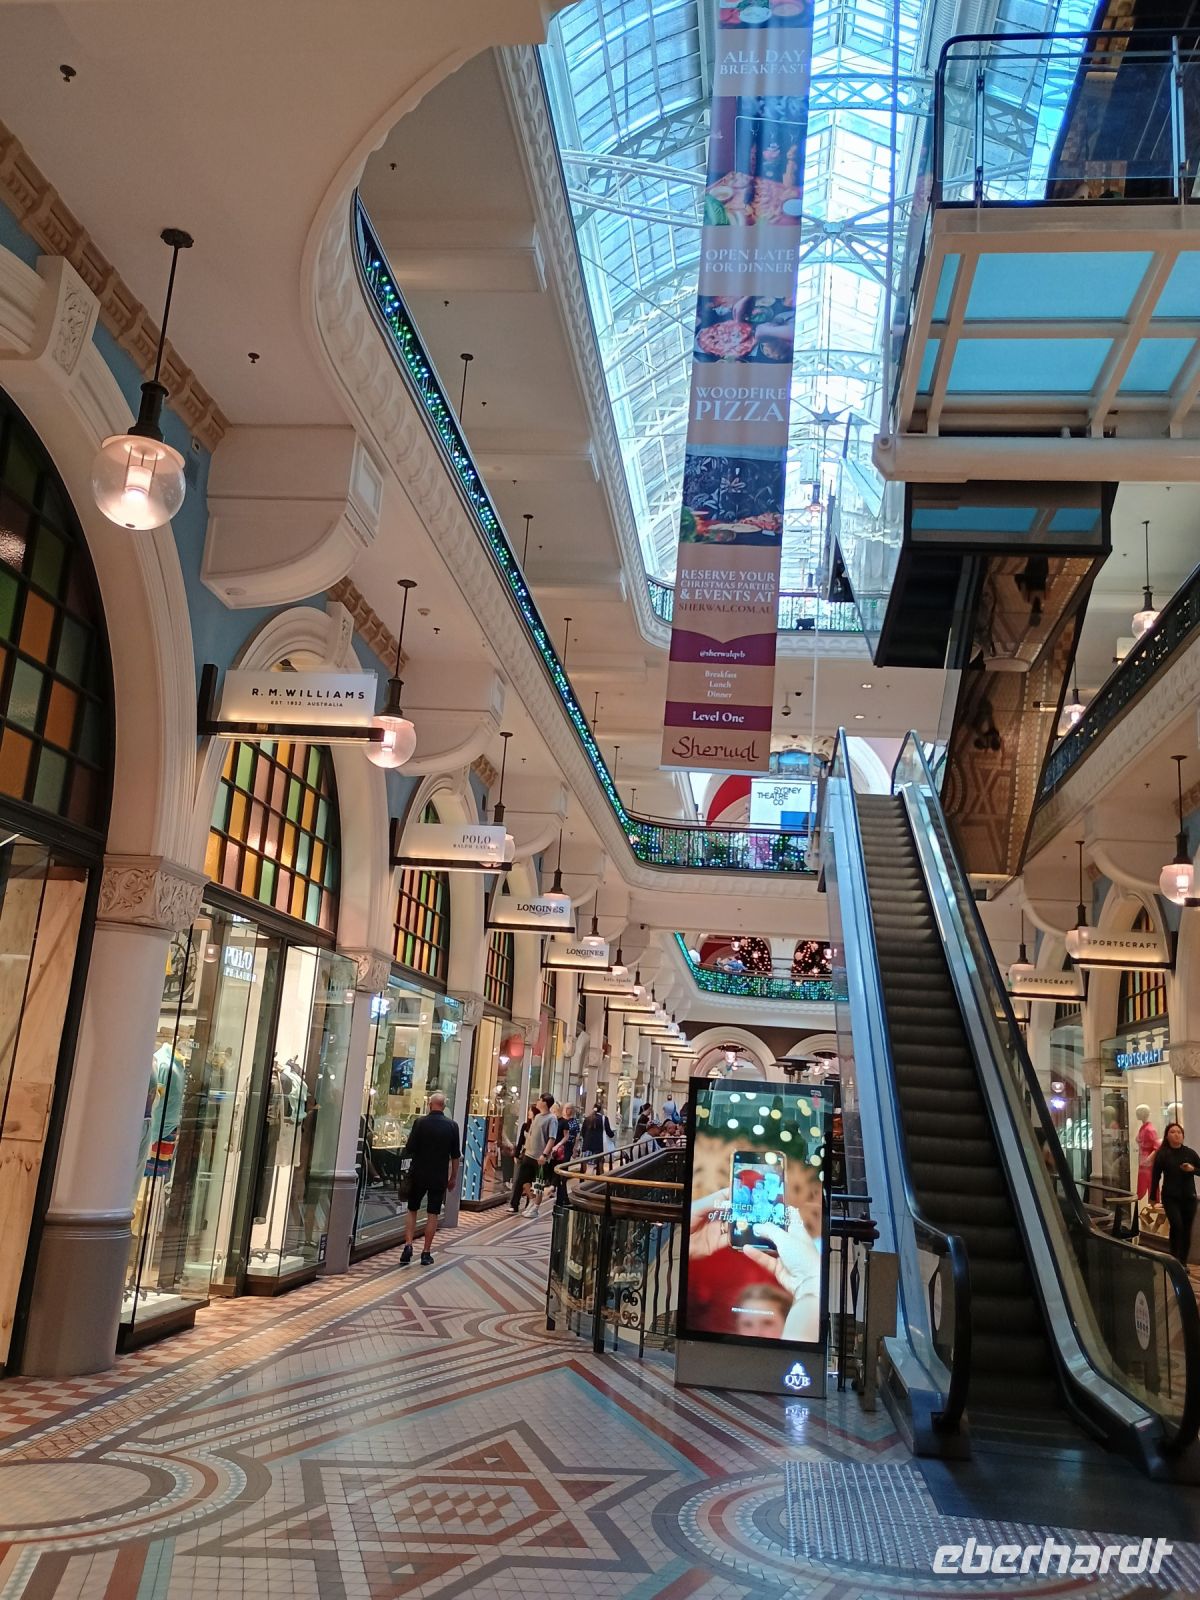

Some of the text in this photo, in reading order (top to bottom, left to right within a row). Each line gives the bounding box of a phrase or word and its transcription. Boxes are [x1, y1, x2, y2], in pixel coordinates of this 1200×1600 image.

[723, 49, 806, 63] ALL DAY
[720, 63, 807, 75] BREAKFAST
[705, 248, 795, 261] OPEN LATE
[705, 262, 793, 273] FOR DINNER
[695, 386, 786, 401] WOODFIRE
[694, 400, 784, 422] PIZZA
[681, 568, 776, 582] RESERVE YOUR
[680, 580, 775, 590] CHRISTMAS PARTIES
[680, 589, 775, 603] & EVENTS AT
[678, 602, 774, 615] SHERWAL.COM.AU
[704, 669, 737, 679] Breakfast
[709, 680, 732, 689] Lunch
[706, 690, 733, 699] Dinner
[691, 711, 745, 724] Level One
[671, 735, 760, 762] Sherwal
[757, 791, 789, 800] THEATRE
[773, 786, 802, 795] SYDNEY
[462, 834, 492, 845] POLO
[516, 903, 565, 914] LONGINES
[1087, 939, 1159, 950] SPORTSCRAFT
[224, 946, 253, 970] POLO
[565, 948, 605, 957] LONGINES
[1116, 1048, 1162, 1069] SPORTSCRAFT
[708, 1211, 718, 1222] of
[785, 1374, 811, 1387] QVB
